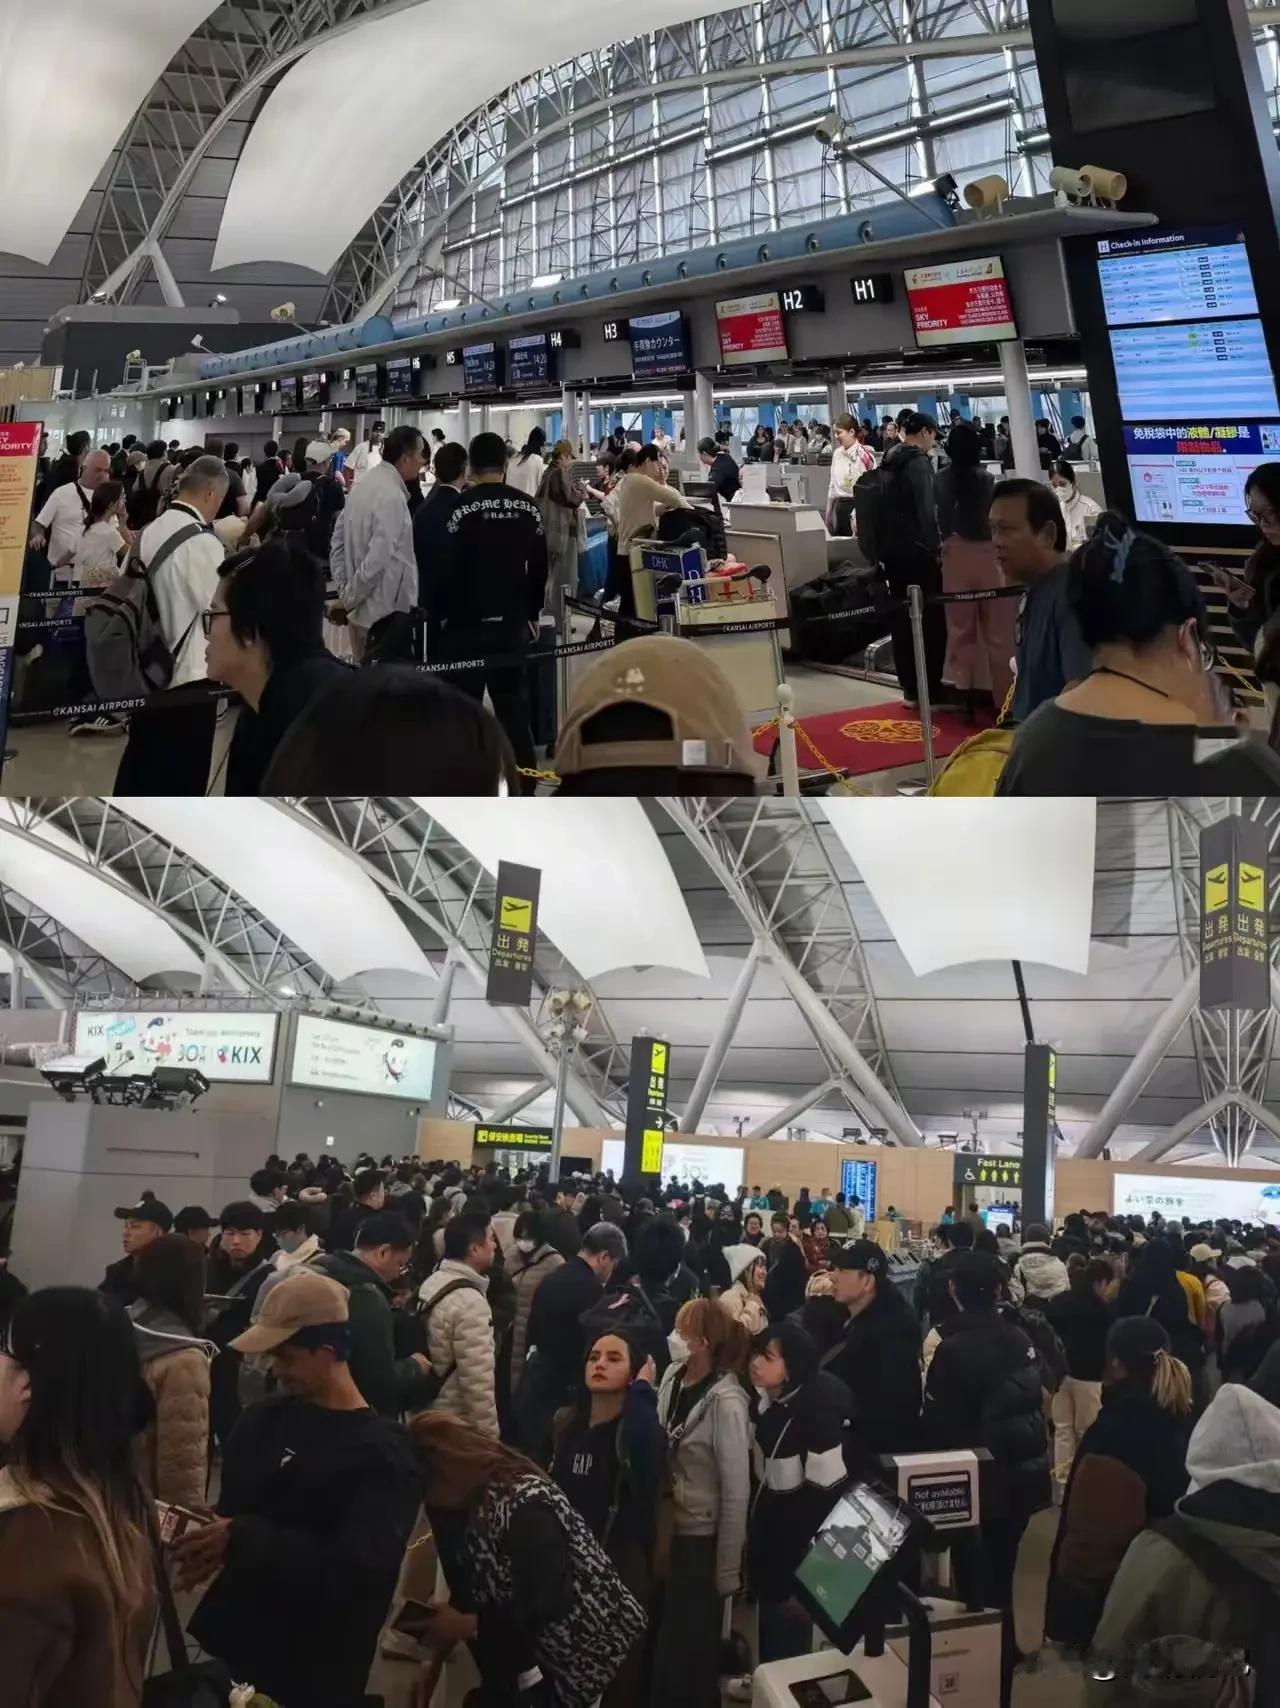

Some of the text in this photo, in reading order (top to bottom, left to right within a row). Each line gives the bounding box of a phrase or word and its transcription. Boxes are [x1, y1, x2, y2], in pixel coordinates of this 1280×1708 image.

[1111, 238, 1141, 250] Check-in
[1142, 234, 1185, 246] Information
[854, 279, 875, 300] H1
[783, 290, 803, 310] H2
[915, 313, 929, 321] SKY
[916, 319, 948, 328] PRIORITY
[550, 332, 562, 347] H4
[604, 324, 618, 339] H3
[446, 352, 455, 364] H5
[559, 638, 616, 655] KANSAI AIRPORTS
[421, 660, 485, 672] KANSAI AIRPORTS
[60, 702, 97, 716] KANSAI
[98, 698, 146, 712] AIRPORTS
[1237, 913, 1264, 937] 出発
[497, 934, 528, 952] 出発
[88, 1026, 104, 1036] KIX
[231, 1046, 262, 1064] KIX
[977, 1158, 1020, 1169] Fast Lane
[572, 1453, 592, 1475] GAP
